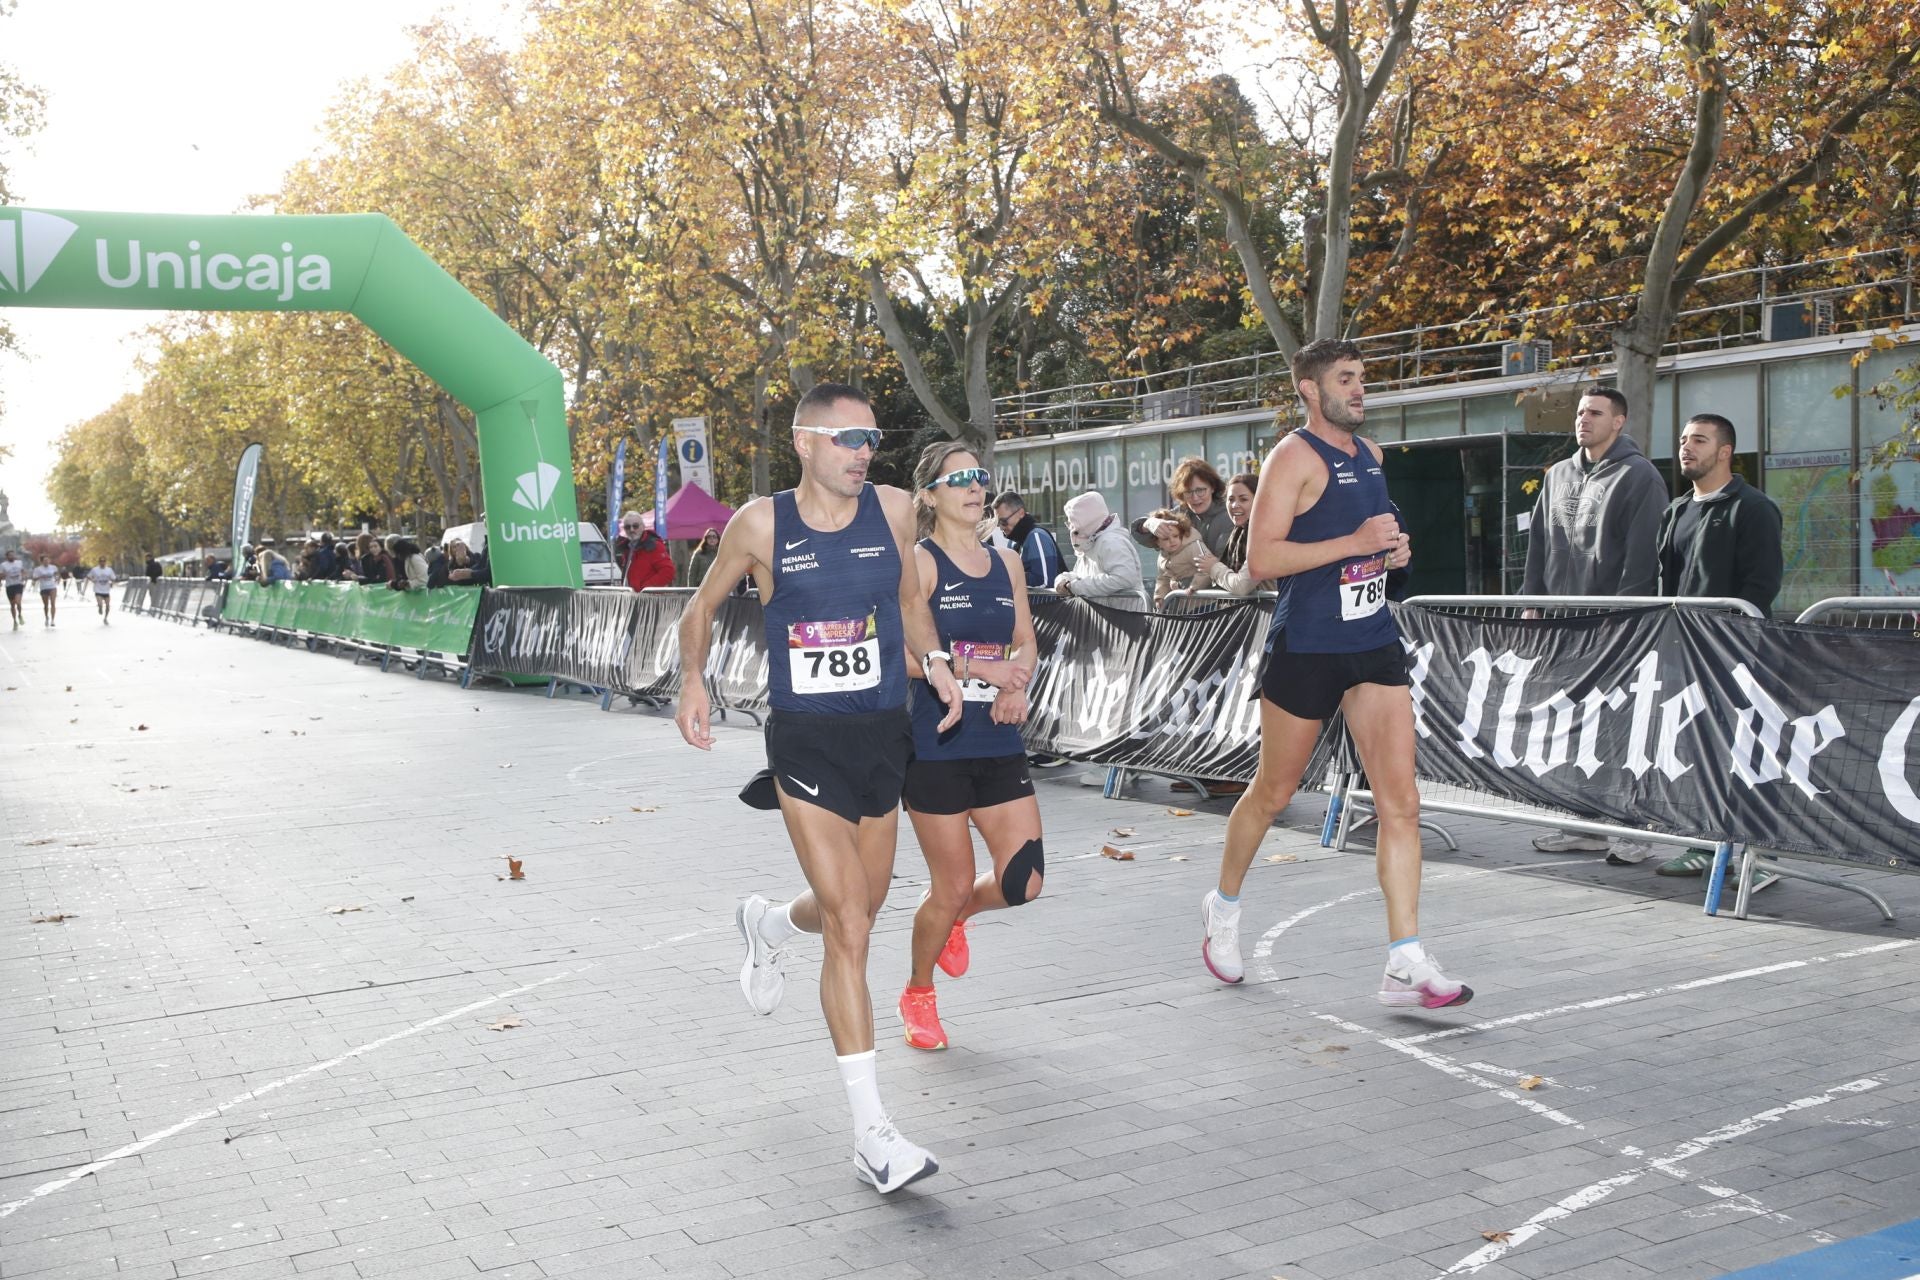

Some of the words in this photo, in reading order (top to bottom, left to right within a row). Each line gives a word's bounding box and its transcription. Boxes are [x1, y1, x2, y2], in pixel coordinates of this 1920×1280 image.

[96, 239, 331, 301] Unicaja
[1803, 454, 1840, 465] VALLADOLID
[993, 455, 1118, 495] VALLADOLID
[501, 517, 576, 544] Unicaja
[782, 553, 816, 565] RENAULT
[850, 546, 885, 554] DEPARTAMENTO
[782, 561, 820, 574] PALENCIA
[1350, 577, 1384, 608] 789
[939, 602, 973, 610] PALENCIA
[820, 630, 856, 639] EMPRESAS
[804, 647, 871, 678] 788
[1458, 647, 1706, 783] Norte
[1729, 662, 1846, 801] de
